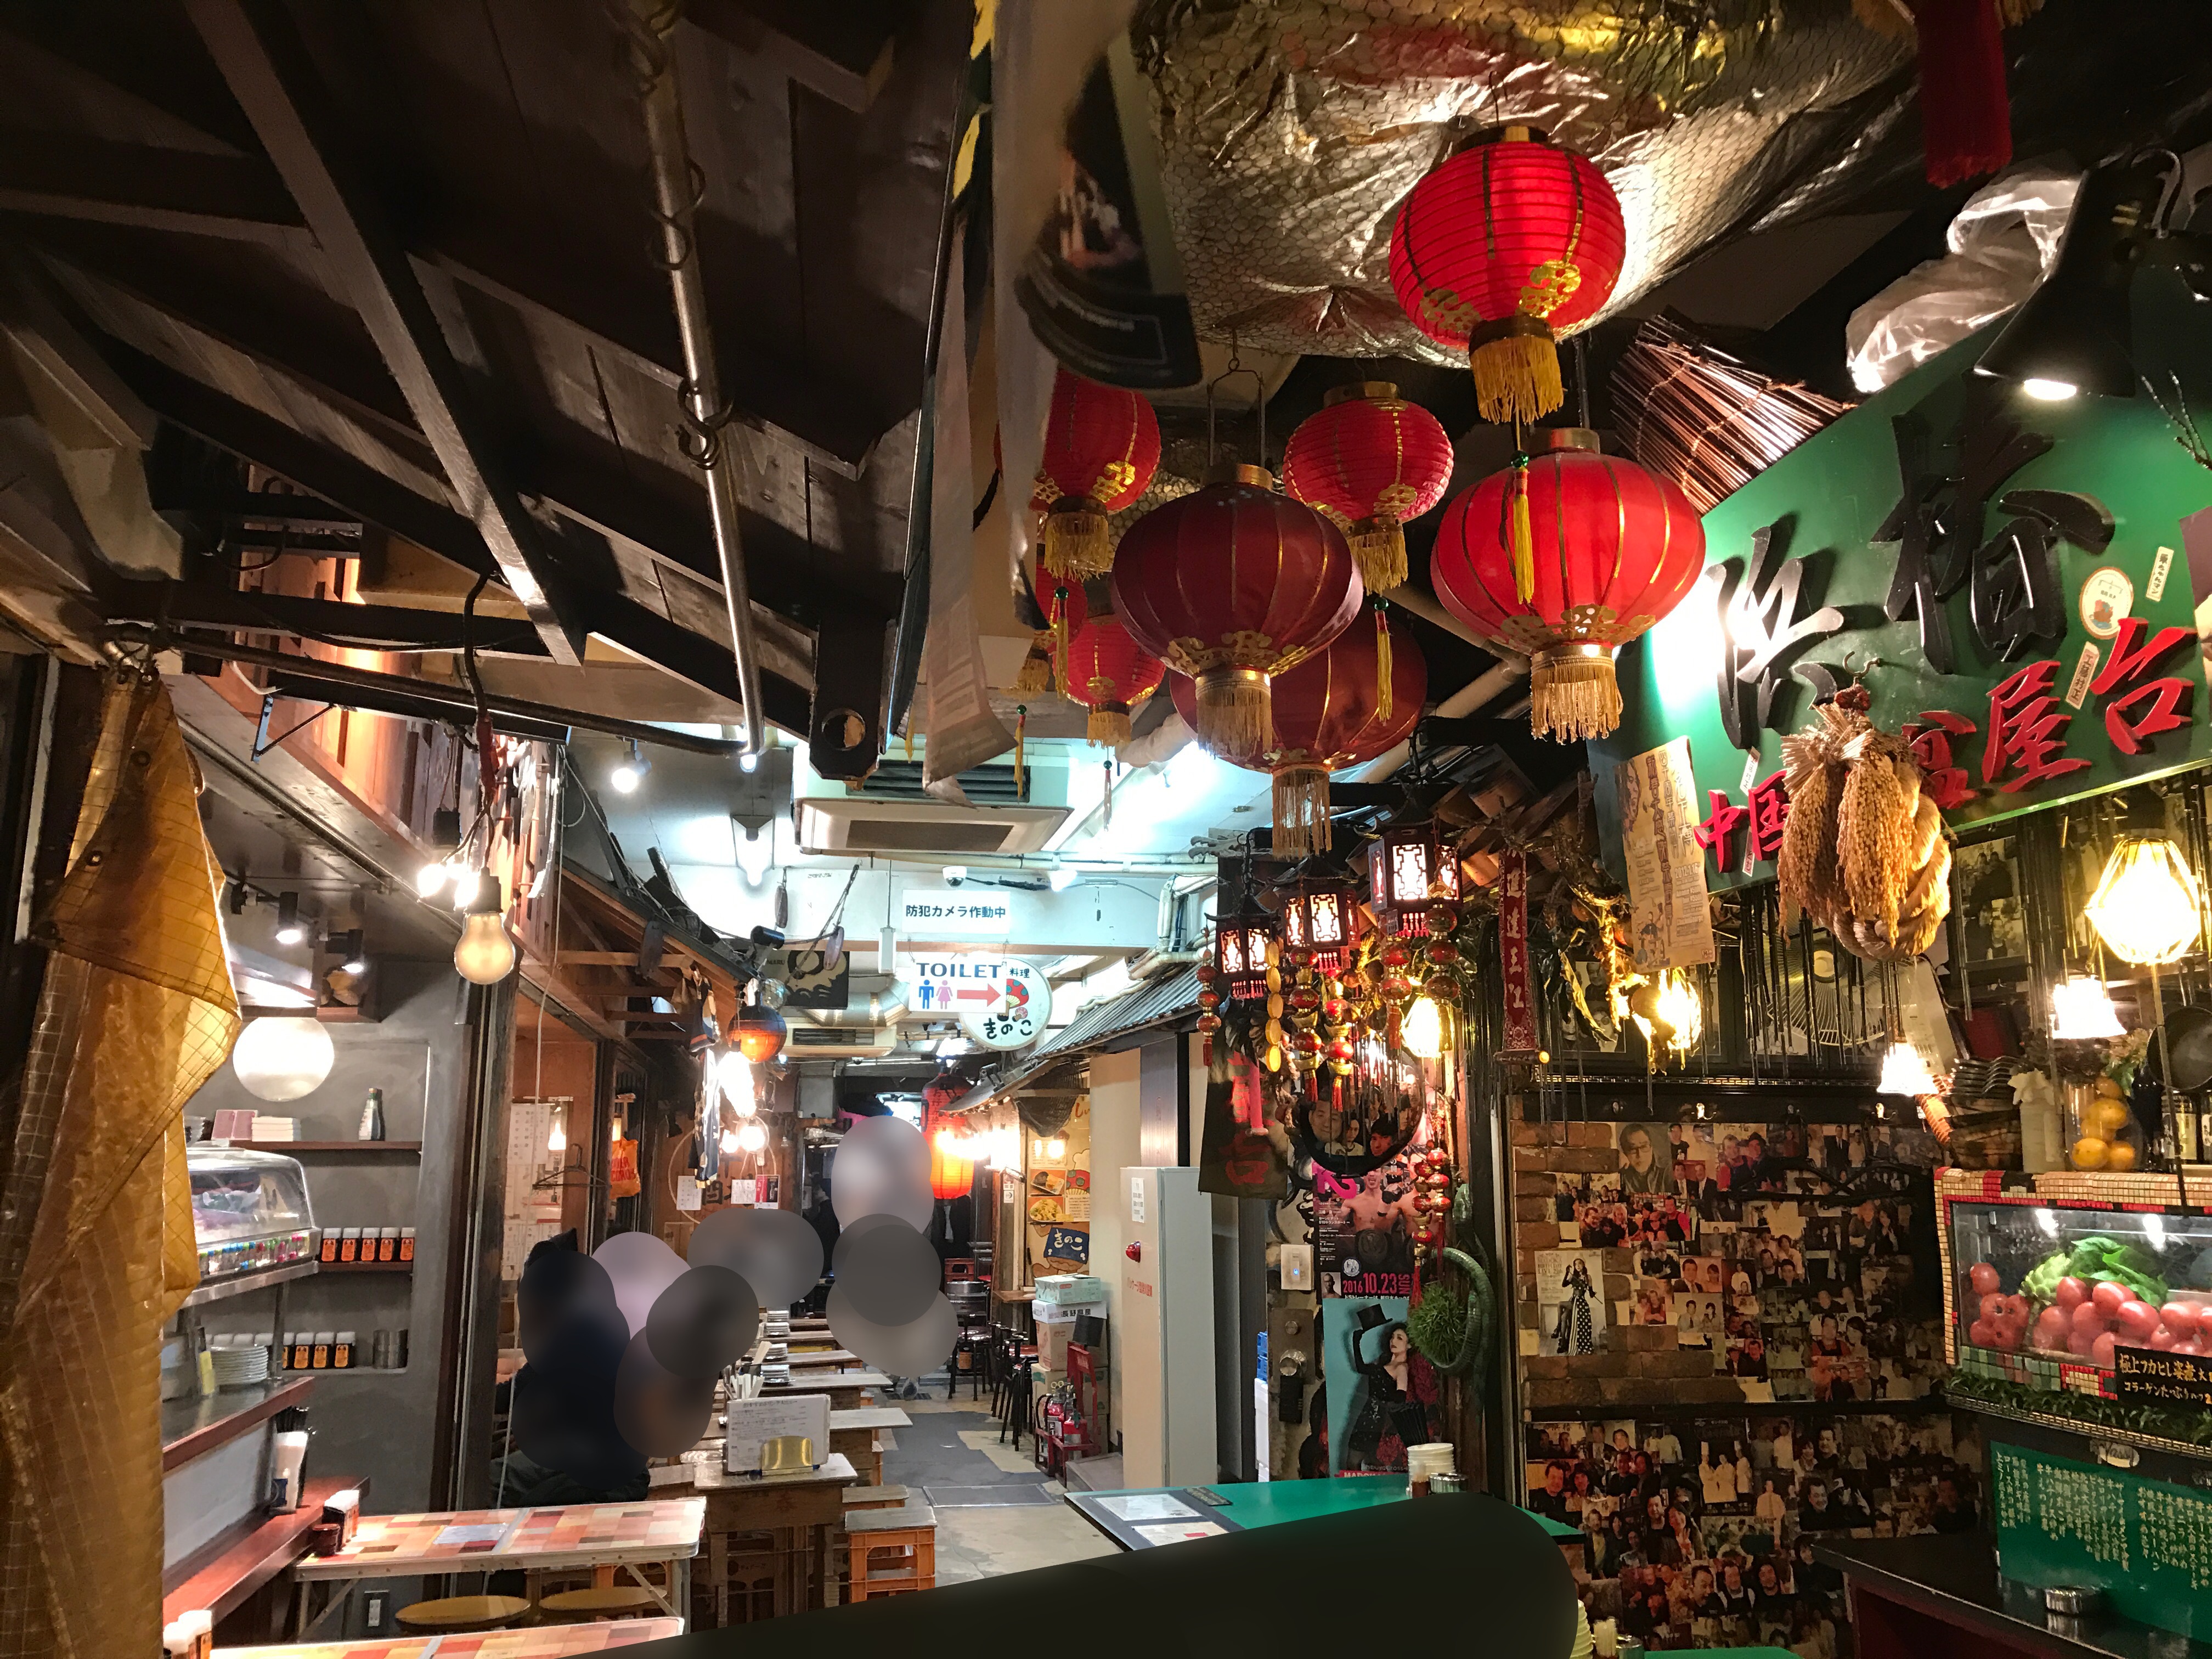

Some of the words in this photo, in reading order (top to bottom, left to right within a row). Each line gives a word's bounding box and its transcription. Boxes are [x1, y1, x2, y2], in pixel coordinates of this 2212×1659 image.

[905, 904, 1006, 918] 防犯カメラ作動中
[916, 962, 1002, 978] TOILET
[1009, 967, 1030, 979] 料理
[983, 1017, 1032, 1040] きのこ
[1054, 1228, 1083, 1250] きのこ
[1343, 1280, 1363, 1294] 2016
[1363, 1272, 1397, 1294] 10.23
